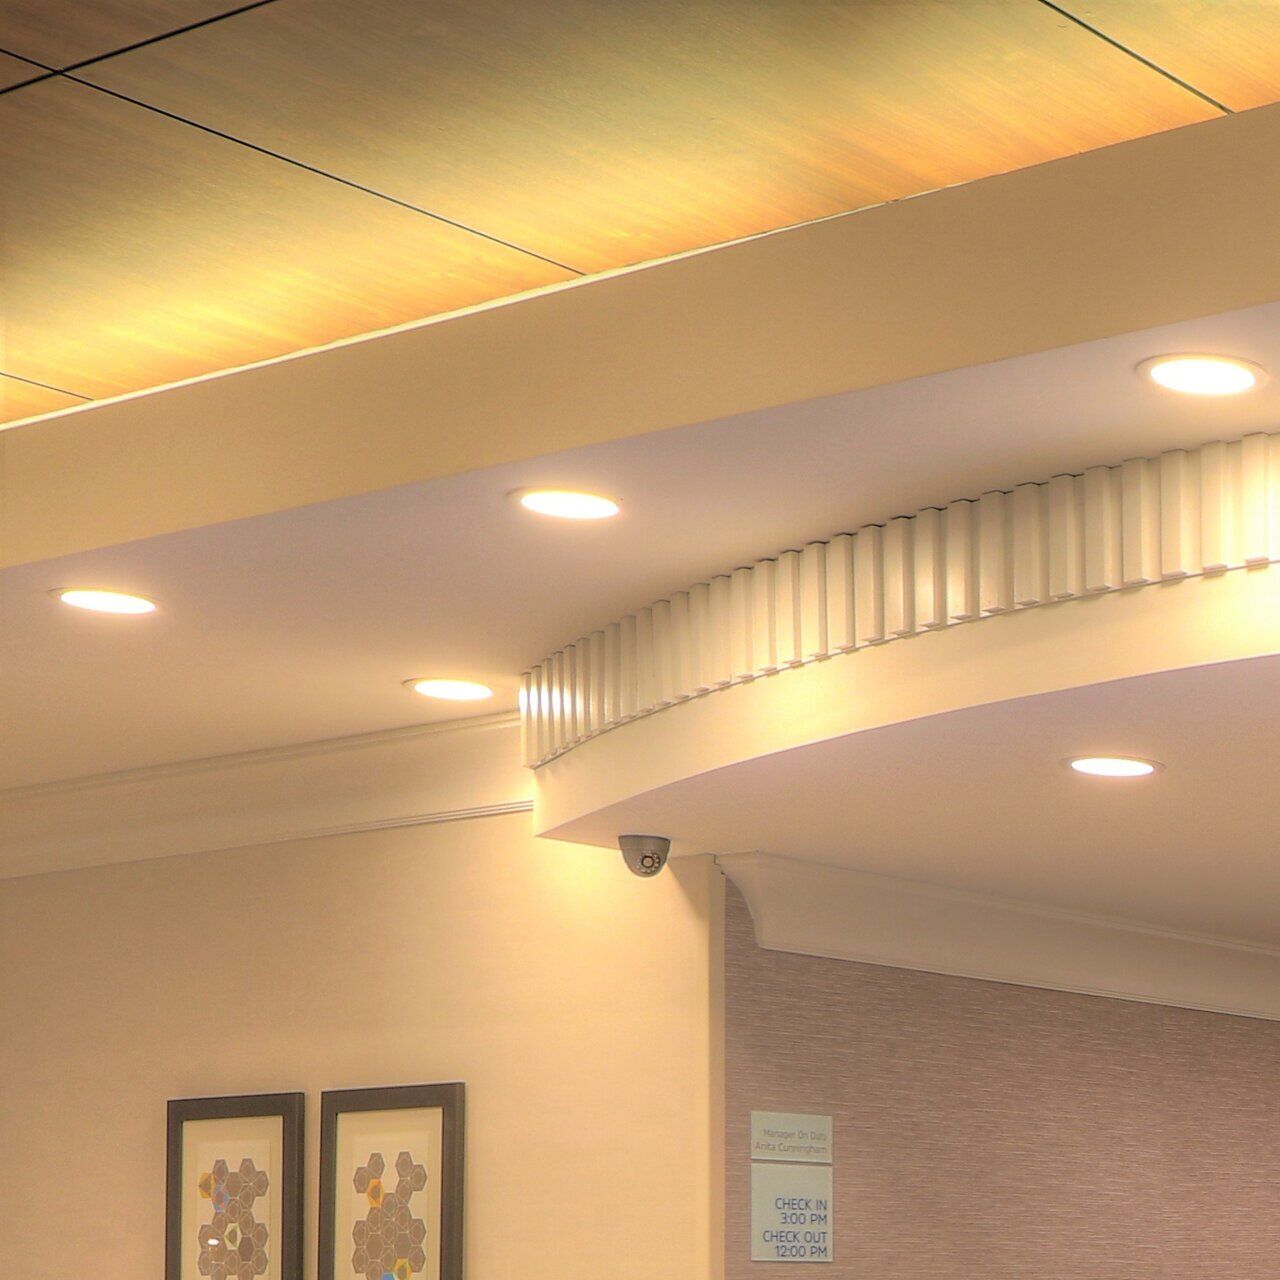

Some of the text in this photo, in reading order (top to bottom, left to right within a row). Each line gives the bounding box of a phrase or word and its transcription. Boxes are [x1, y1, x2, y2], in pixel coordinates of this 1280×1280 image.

[775, 1197, 827, 1211] CHECK IN
[780, 1212, 827, 1226] 3:00 PM
[763, 1230, 828, 1244] CHECK OUT
[776, 1245, 827, 1258] 12:00 PM
